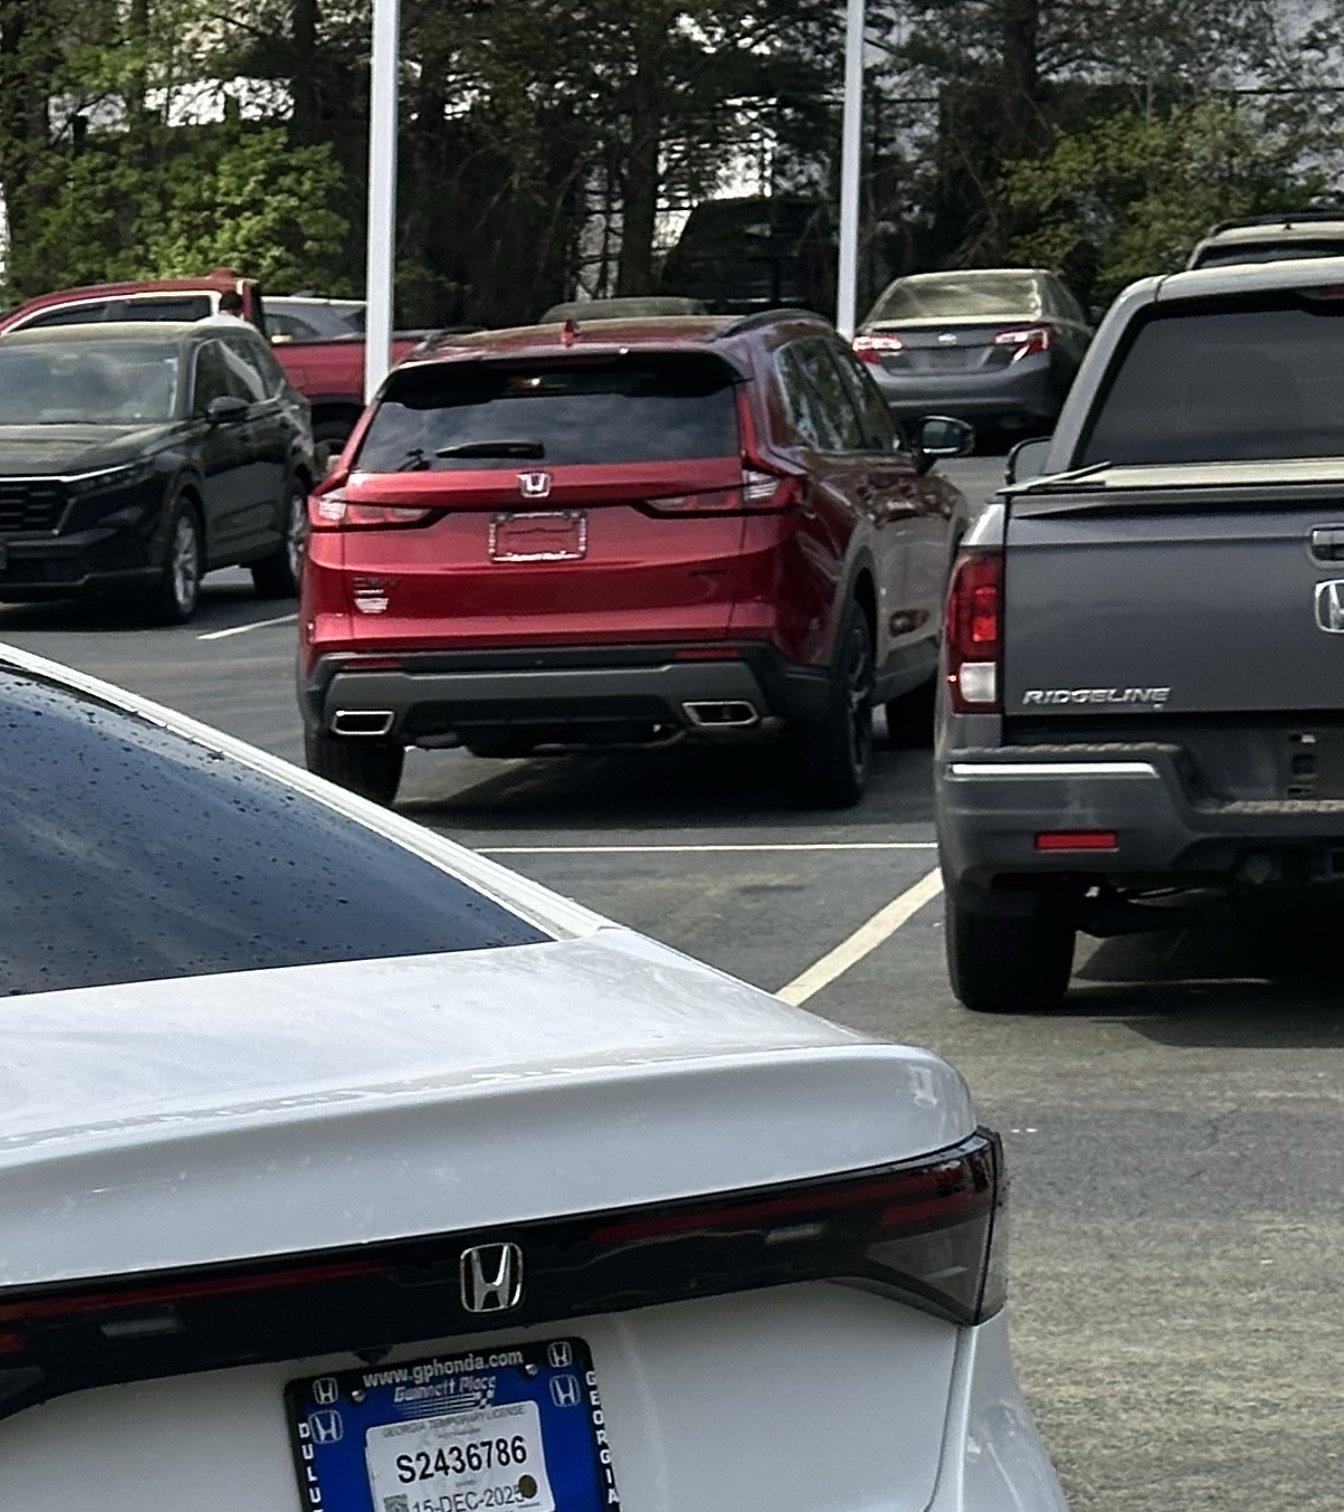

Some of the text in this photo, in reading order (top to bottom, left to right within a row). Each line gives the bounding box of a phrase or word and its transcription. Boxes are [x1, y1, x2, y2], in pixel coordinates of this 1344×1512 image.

[1022, 686, 1172, 706] RIDGELINE
[362, 1348, 524, 1389] www.gphonda.com
[395, 1434, 528, 1485] S2436786
[585, 1370, 621, 1506] GEORGIA
